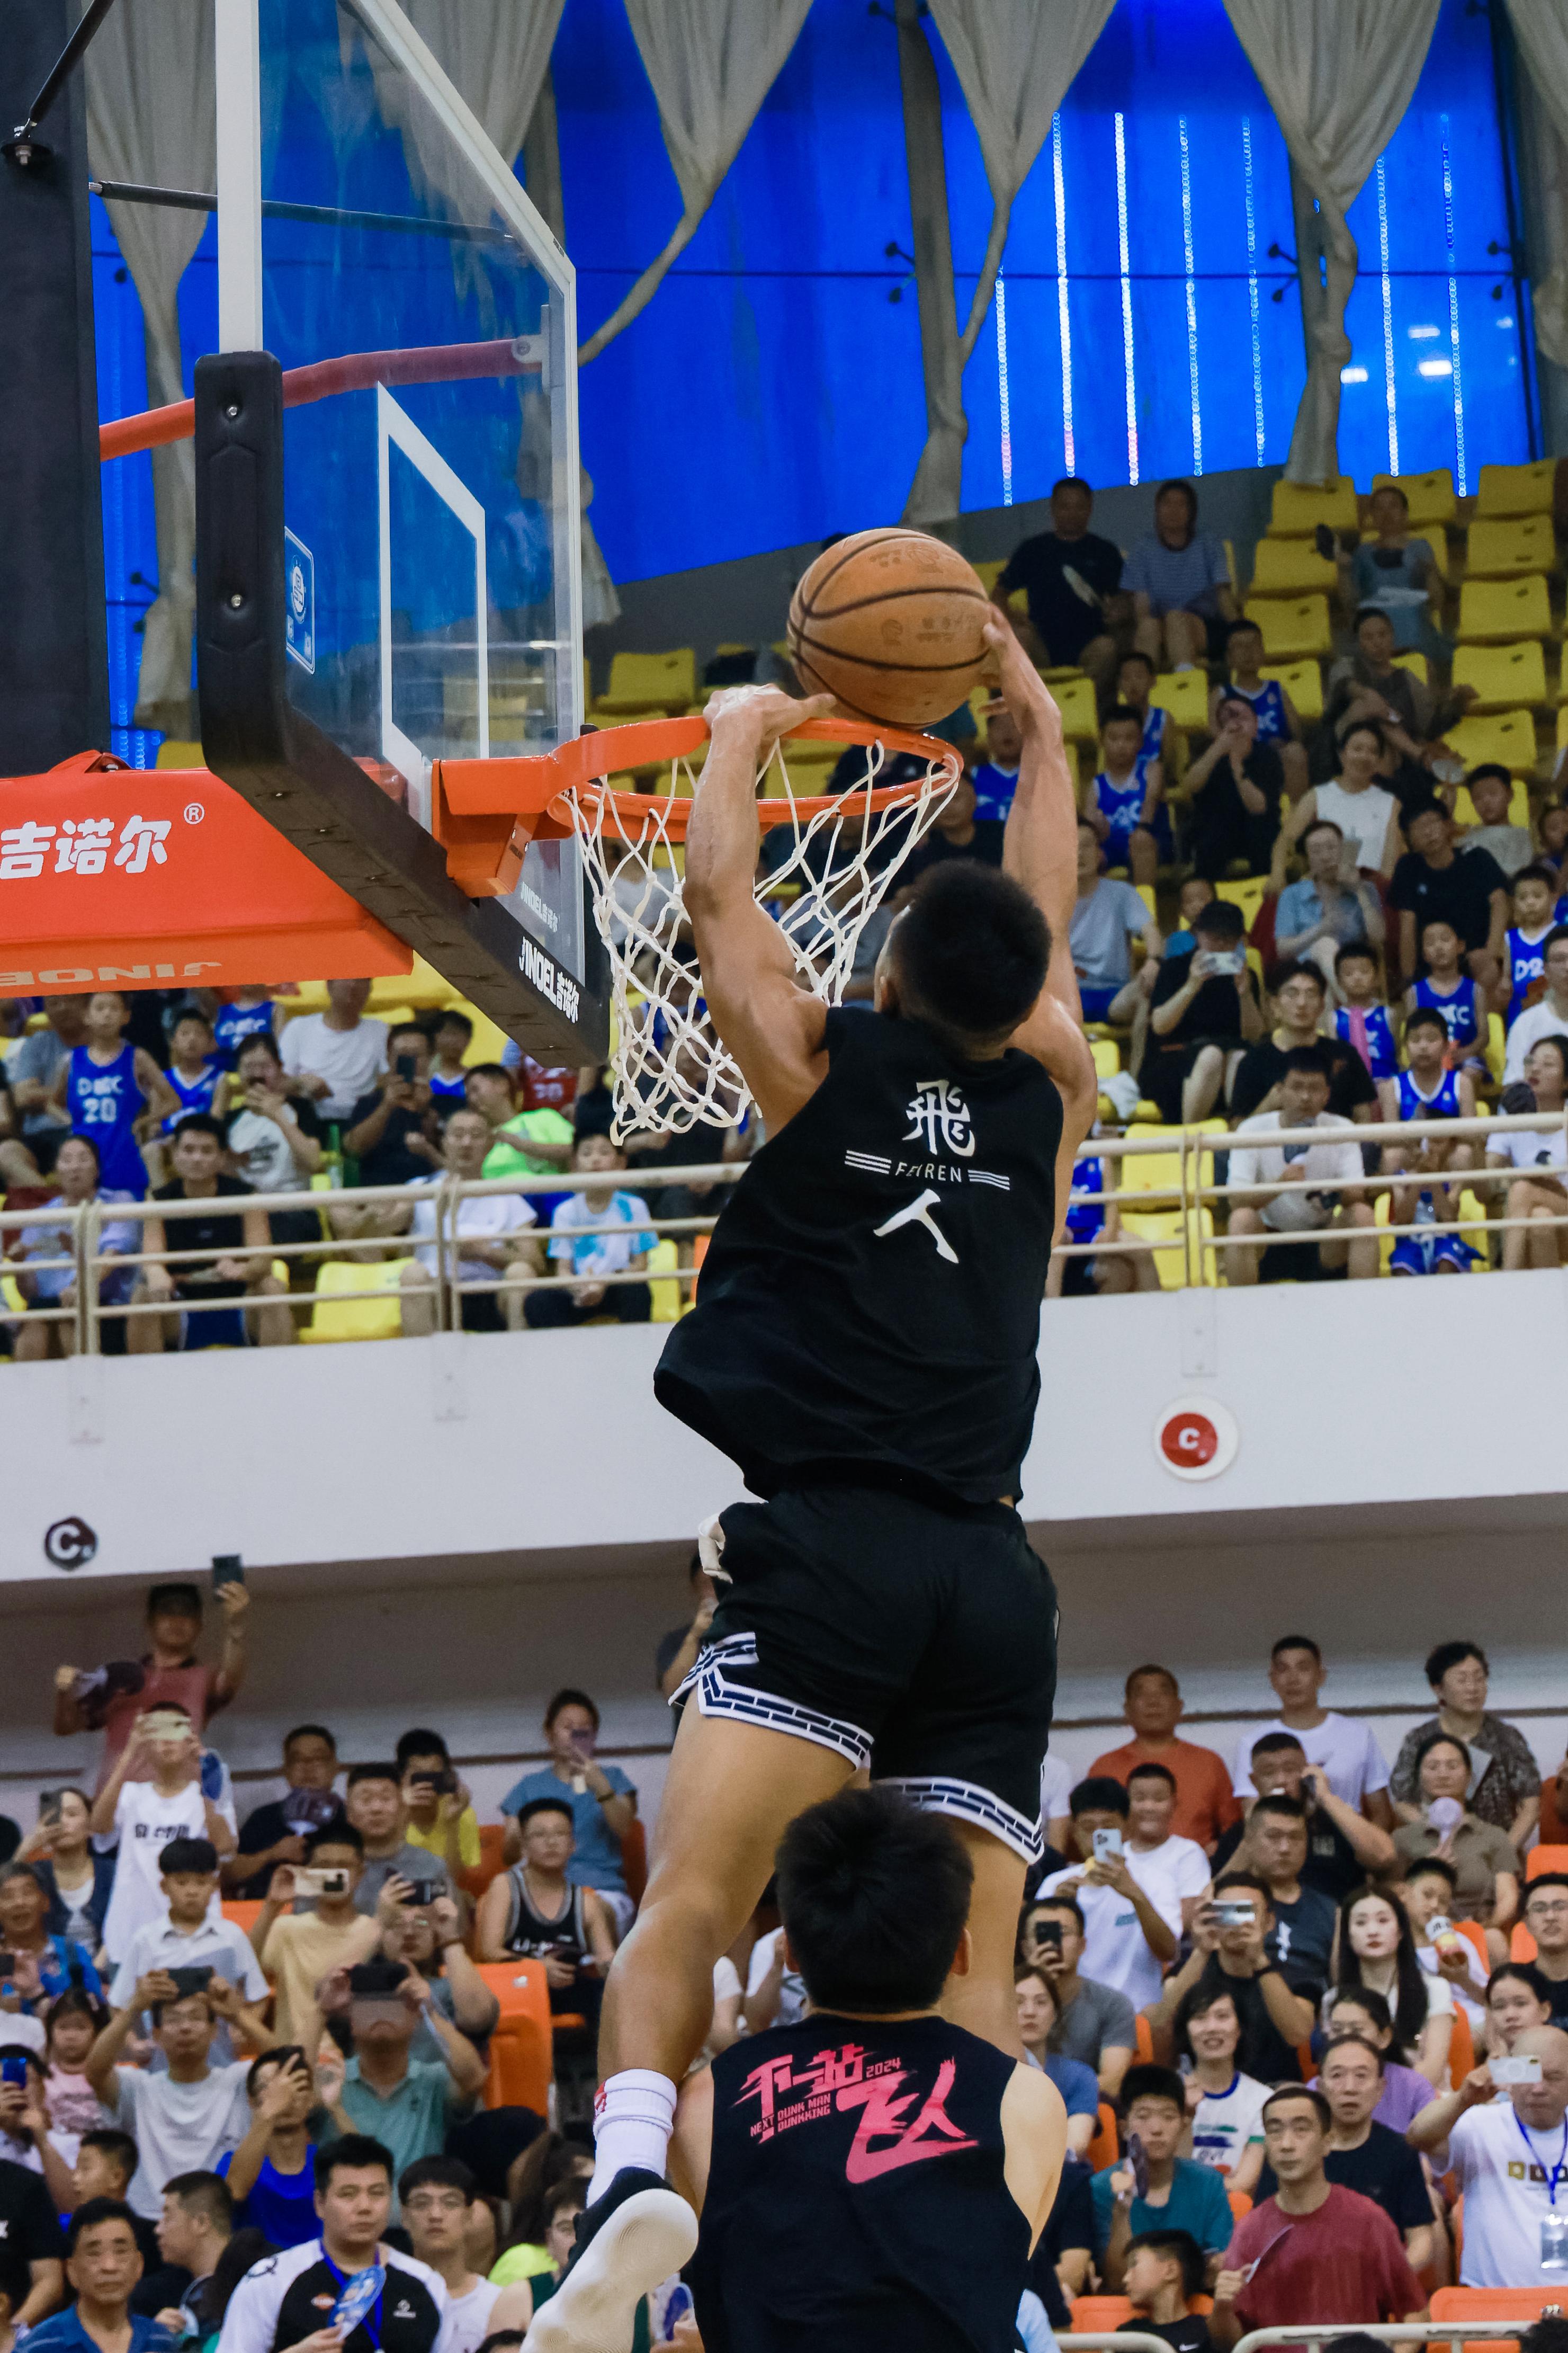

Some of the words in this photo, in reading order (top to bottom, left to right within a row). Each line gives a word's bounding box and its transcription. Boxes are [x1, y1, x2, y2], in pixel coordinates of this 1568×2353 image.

[0, 815, 173, 880] 吉诺尔
[518, 935, 557, 1006] JINOEL
[556, 971, 580, 1023] 吉诺尔
[902, 1079, 975, 1157] 飛
[873, 1188, 960, 1264] 人
[866, 2057, 901, 2079] 2024
[749, 2113, 774, 2137] NEXT
[777, 2101, 805, 2122] DUNK
[808, 2092, 831, 2109] MAN
